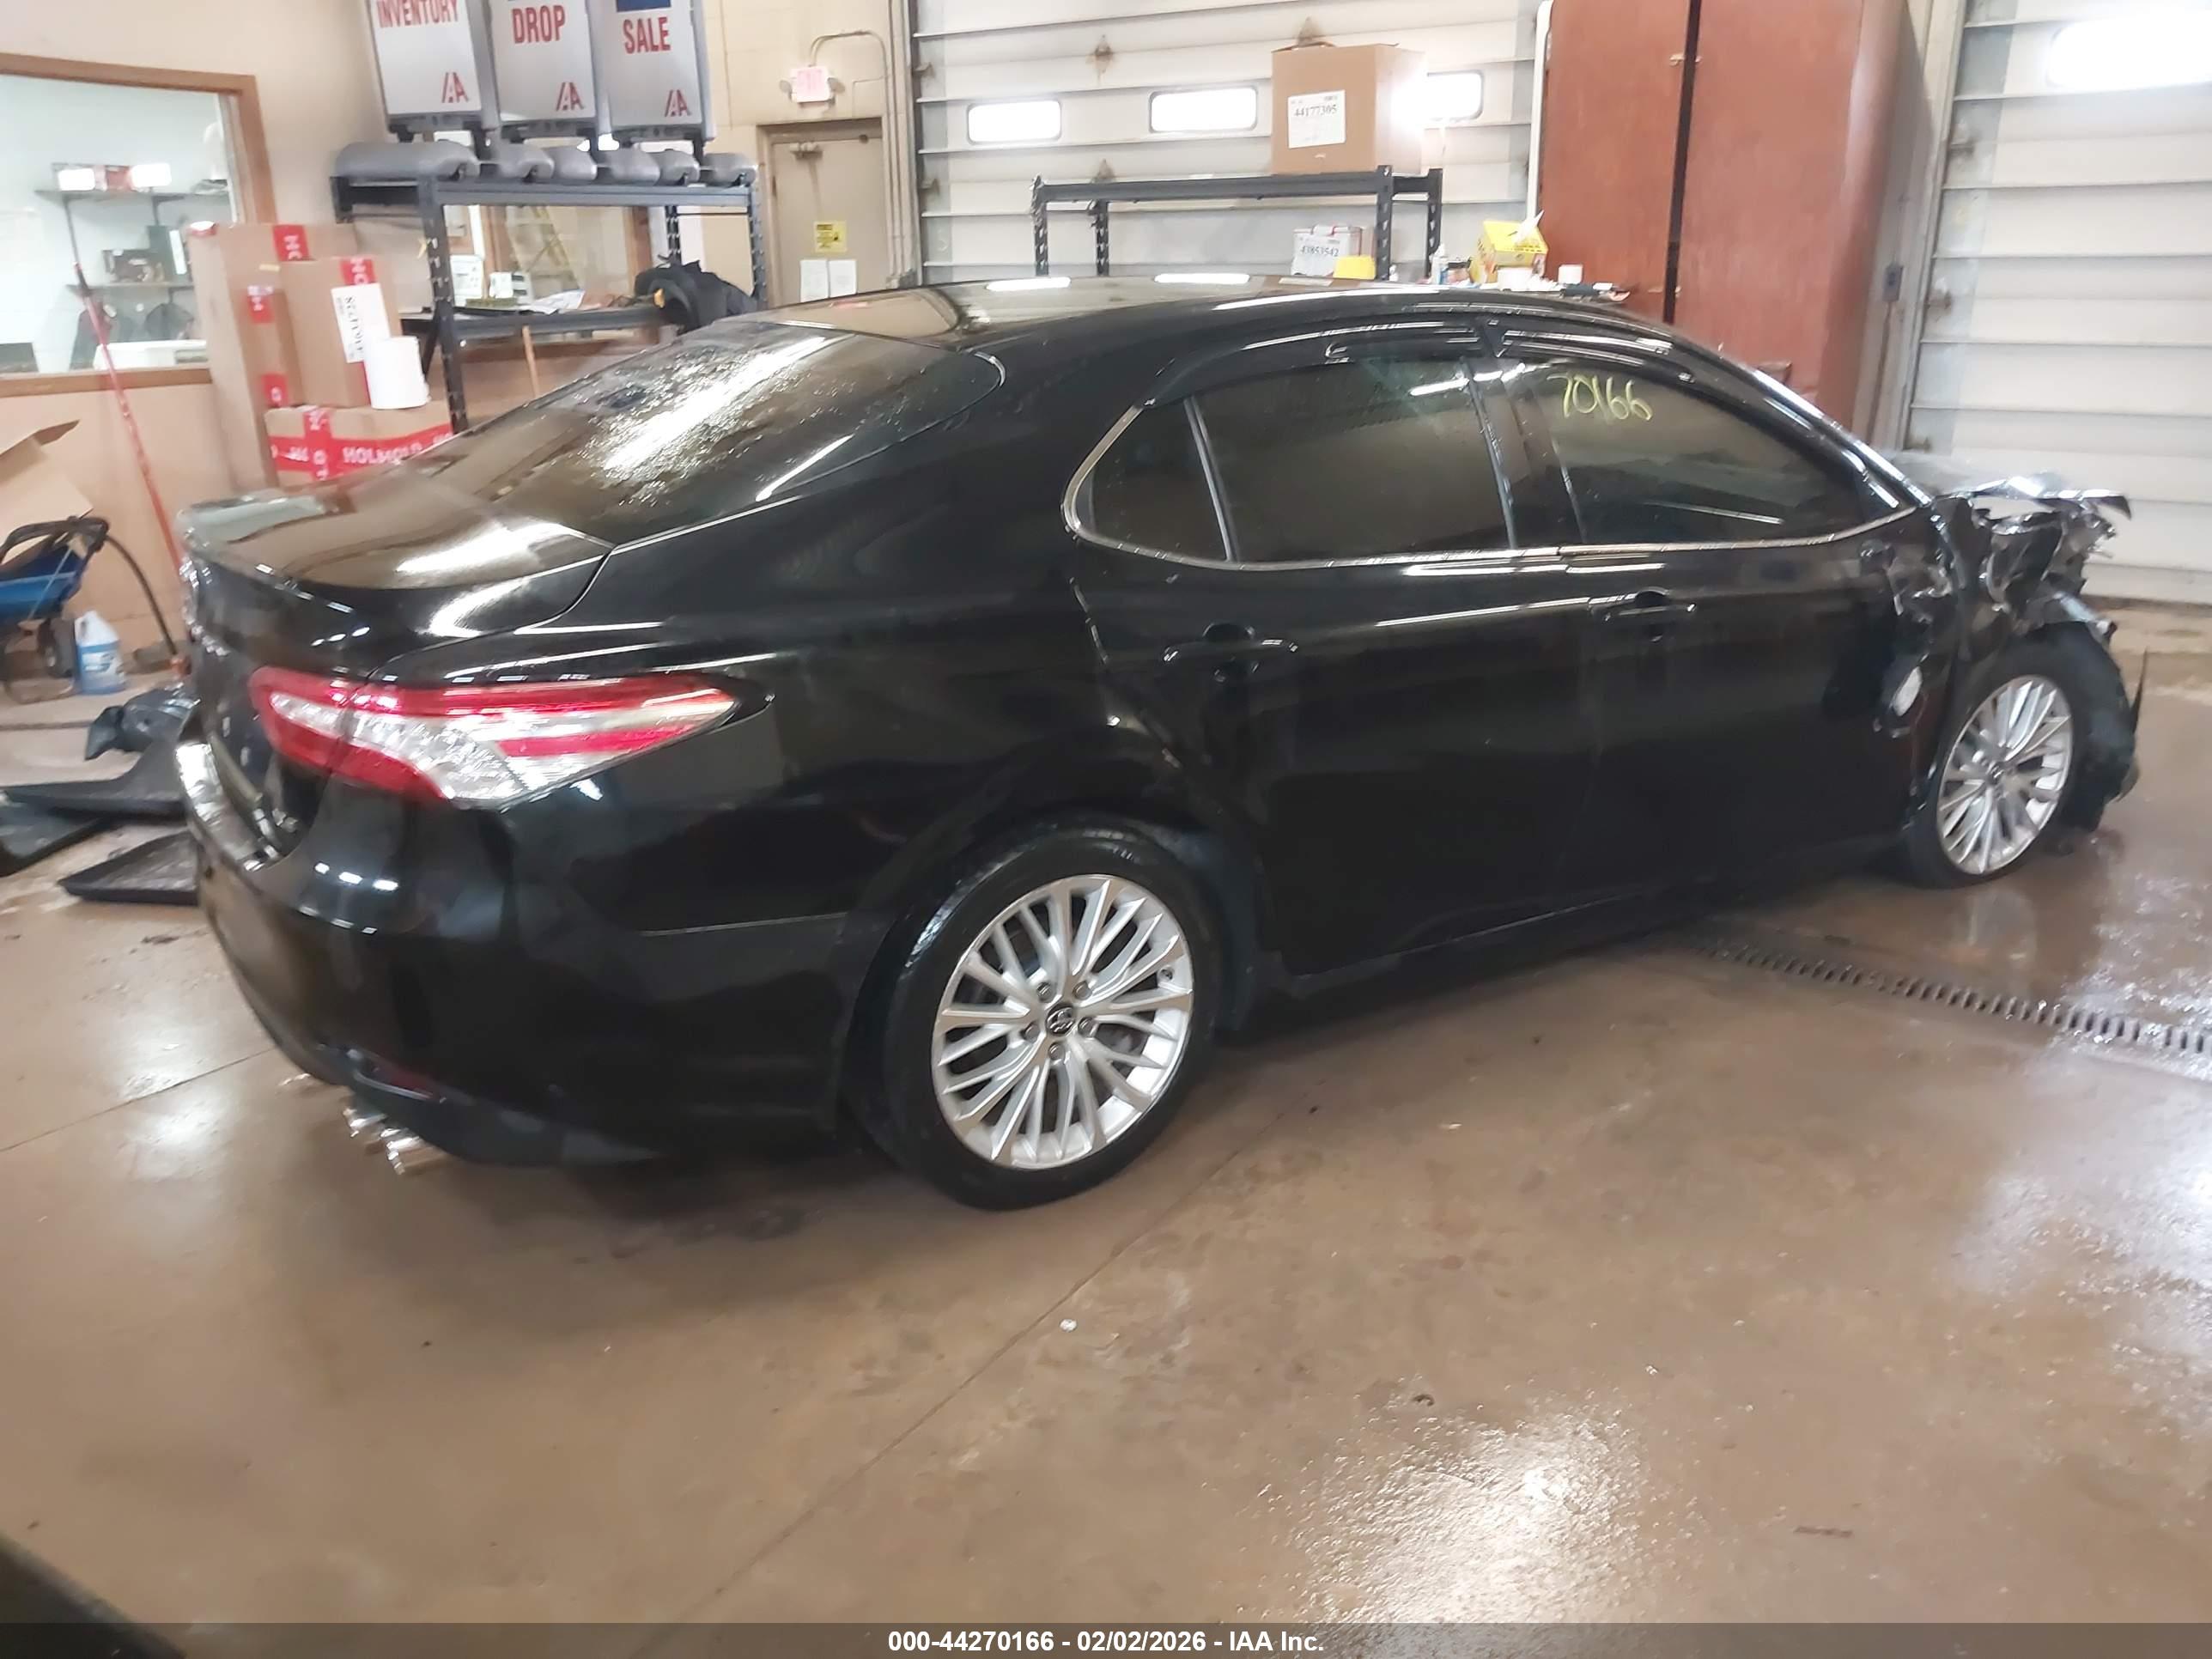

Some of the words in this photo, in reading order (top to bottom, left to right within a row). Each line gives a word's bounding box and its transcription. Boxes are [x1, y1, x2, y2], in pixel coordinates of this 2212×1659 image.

[512, 5, 566, 44] DROP
[623, 17, 672, 54] SALE
[1547, 373, 1654, 423] 70166
